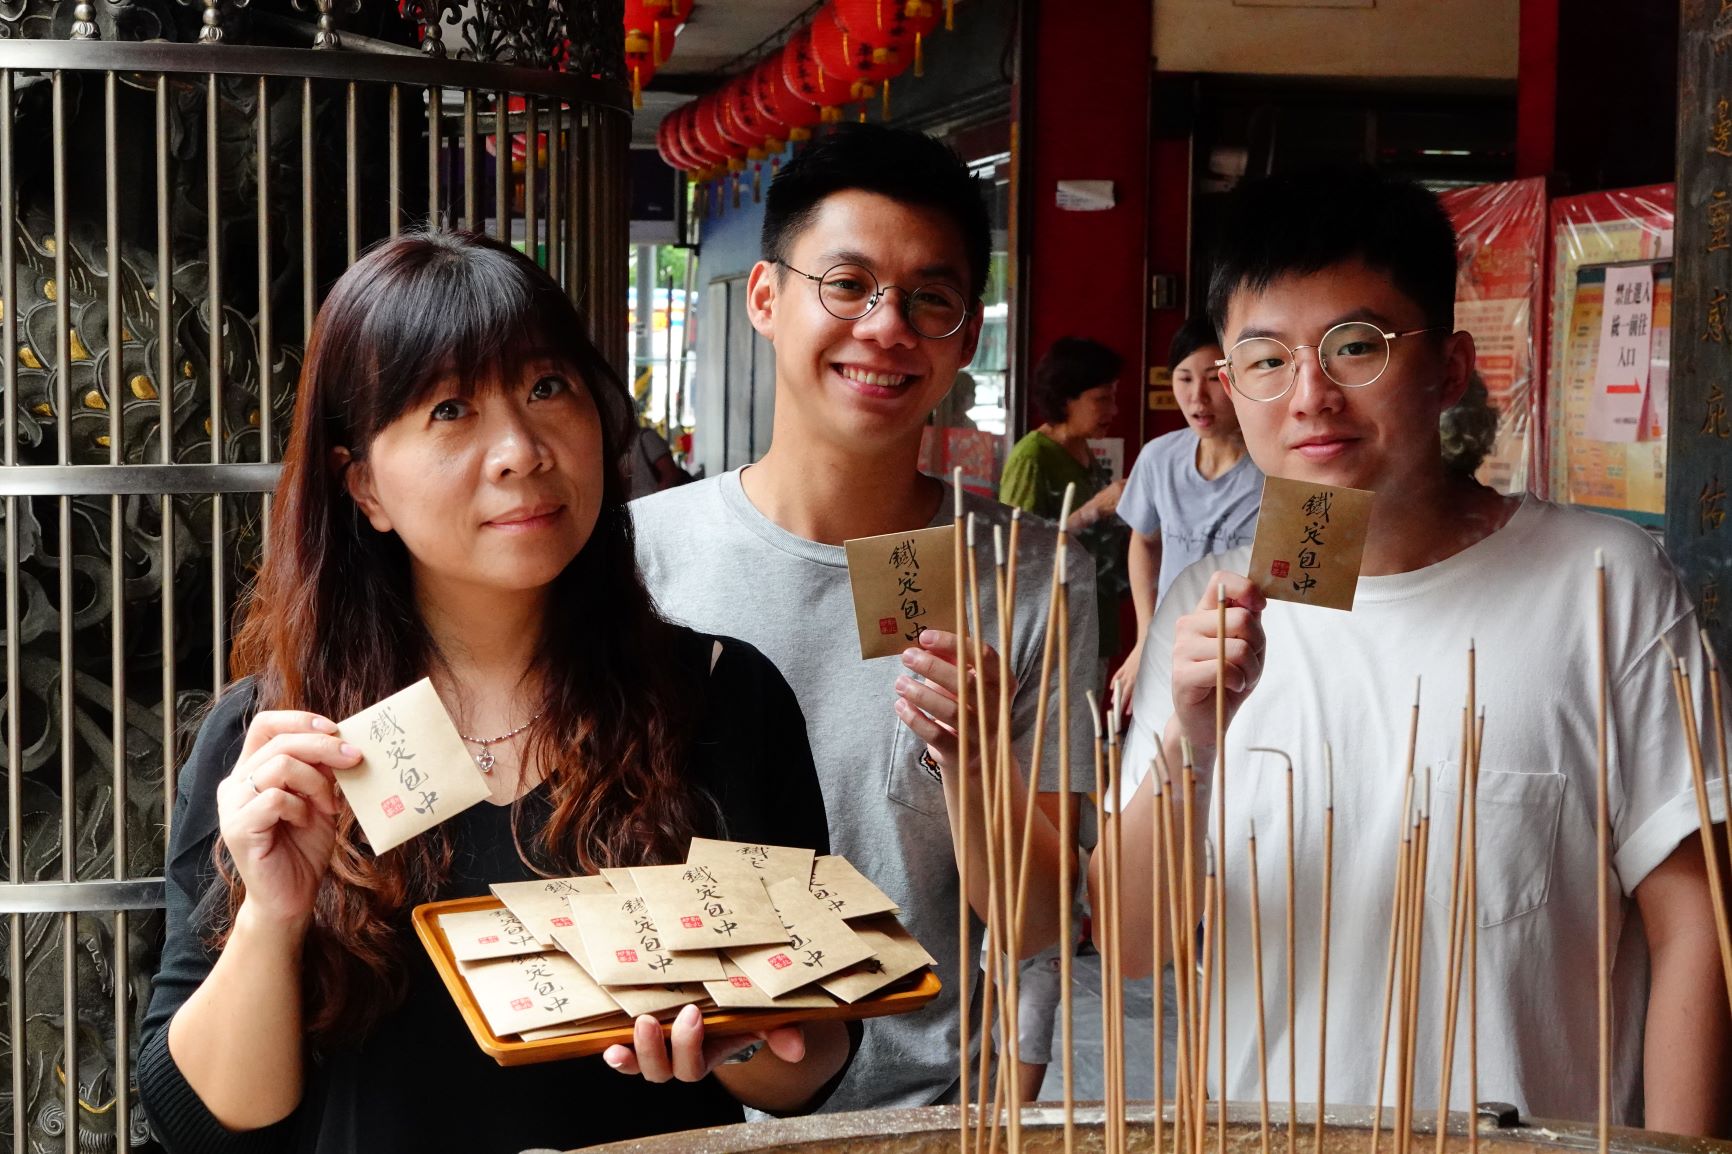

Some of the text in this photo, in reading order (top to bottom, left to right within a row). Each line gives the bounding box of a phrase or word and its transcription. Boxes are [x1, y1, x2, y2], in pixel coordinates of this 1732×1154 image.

[1617, 347, 1636, 367] 入口
[888, 539, 928, 644] 鐵定包中
[1293, 491, 1333, 595] 鐵定包中
[370, 706, 438, 815] 鐵定包中
[682, 865, 738, 937] 鐵定包中
